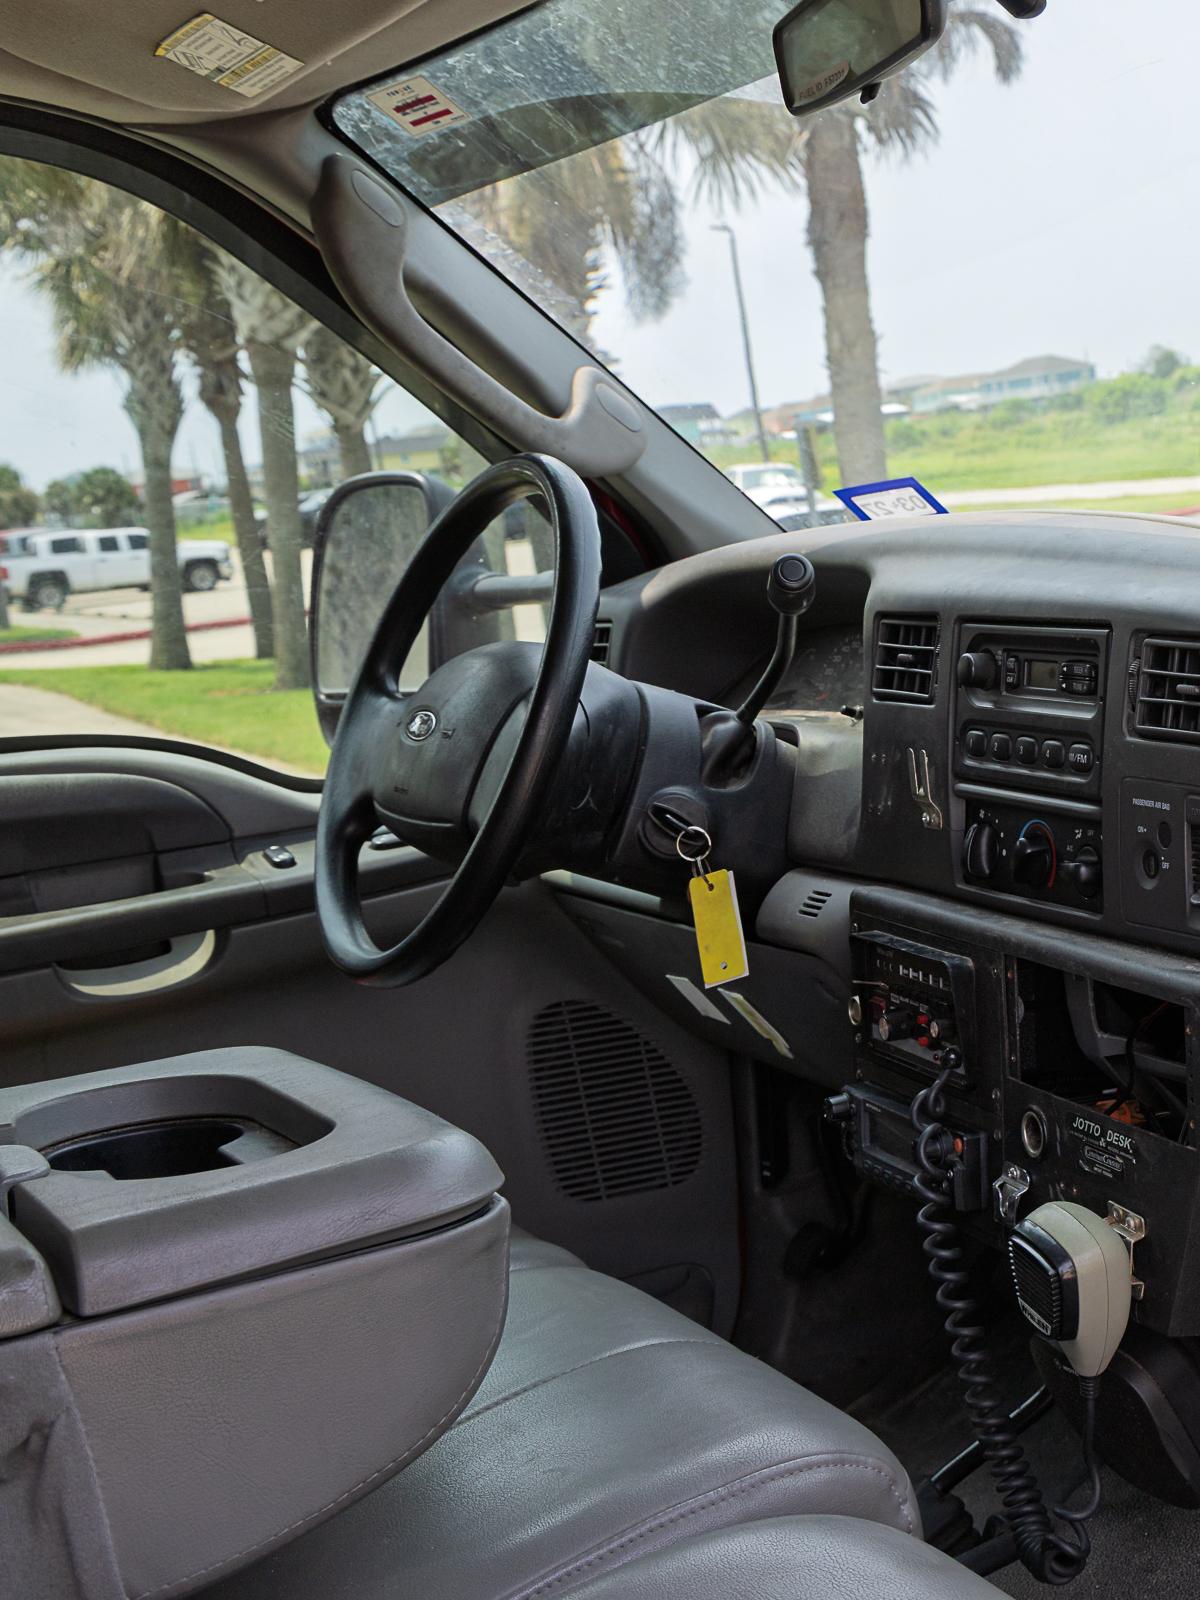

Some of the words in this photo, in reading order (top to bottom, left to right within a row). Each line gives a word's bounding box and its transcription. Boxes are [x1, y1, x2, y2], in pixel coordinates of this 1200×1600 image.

[993, 742, 999, 752] 2
[1018, 745, 1024, 755] 3
[1045, 749, 1051, 759] 4
[1072, 1116, 1101, 1137] JOTTO
[1106, 1129, 1132, 1149] DESK
